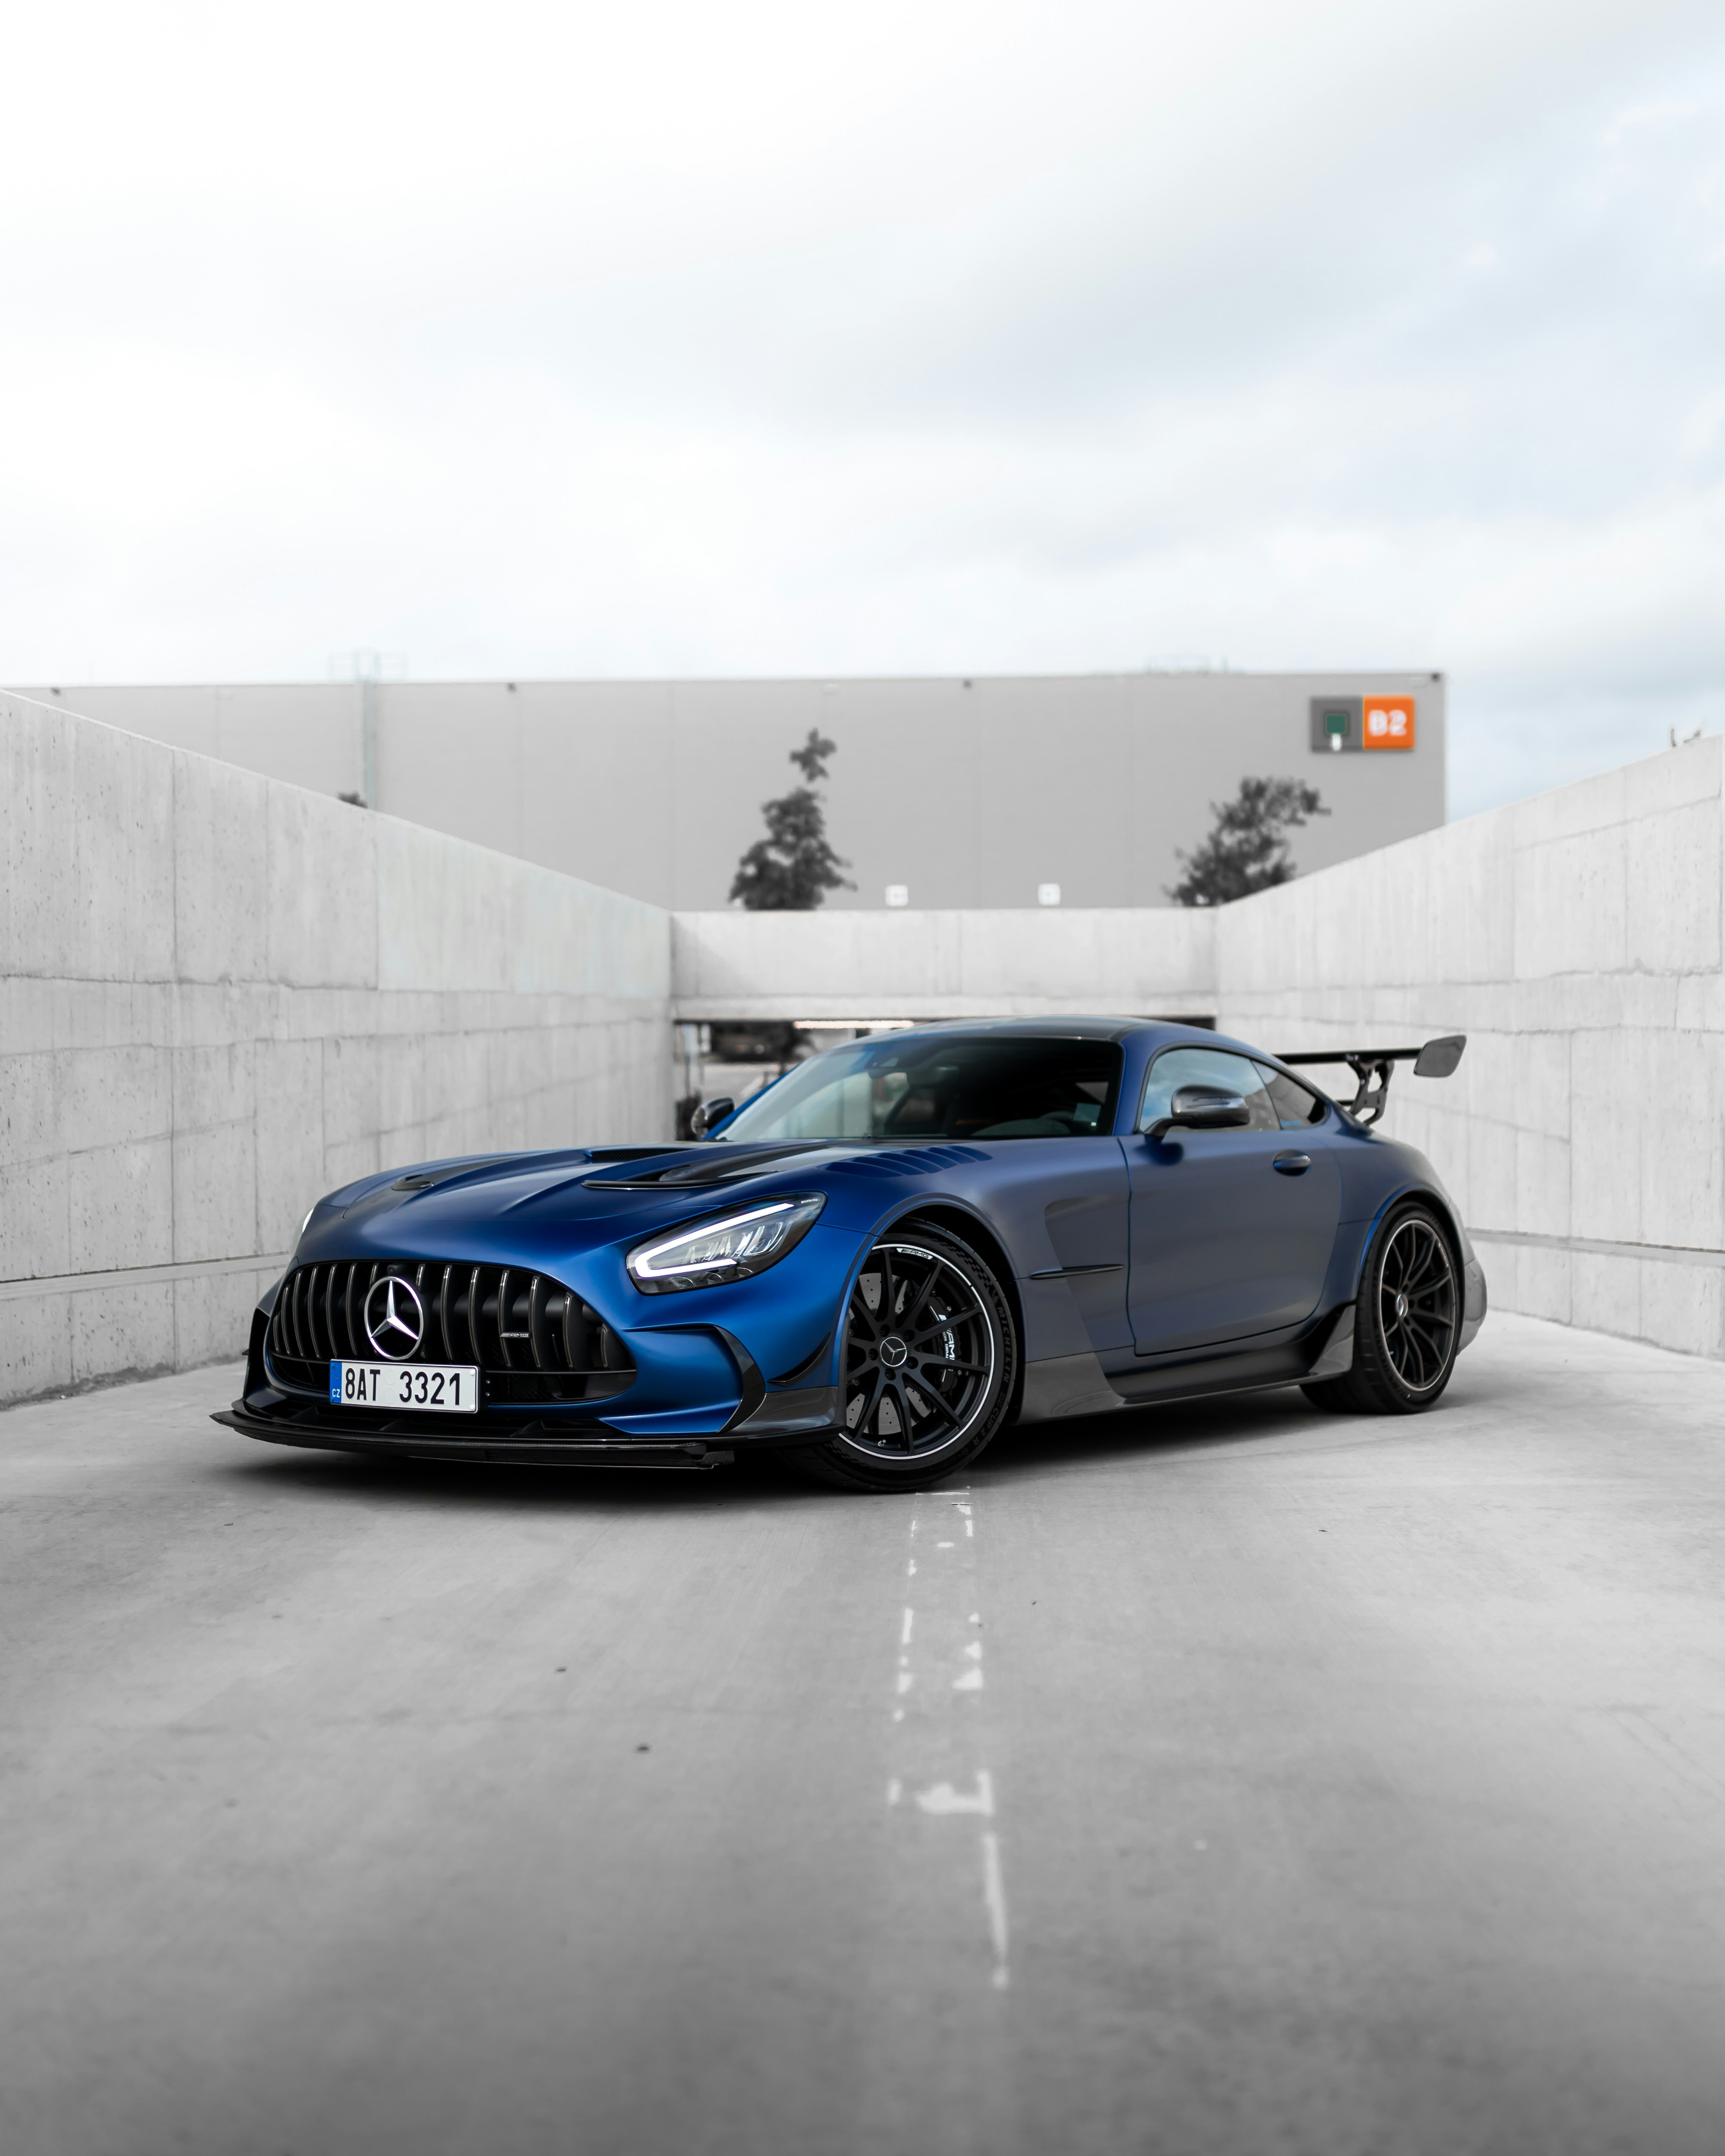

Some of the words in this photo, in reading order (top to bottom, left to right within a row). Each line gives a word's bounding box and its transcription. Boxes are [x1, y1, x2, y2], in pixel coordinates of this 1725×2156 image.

[1368, 709, 1407, 737] B2
[909, 1250, 929, 1258] AMG
[997, 1306, 1012, 1384] MICHELIN
[332, 1388, 340, 1398] CZ
[345, 1367, 381, 1402] 8AT
[399, 1370, 461, 1406] 3321
[987, 1407, 999, 1430] CUP
[980, 1428, 987, 1436] 2
[972, 1436, 980, 1446] R
